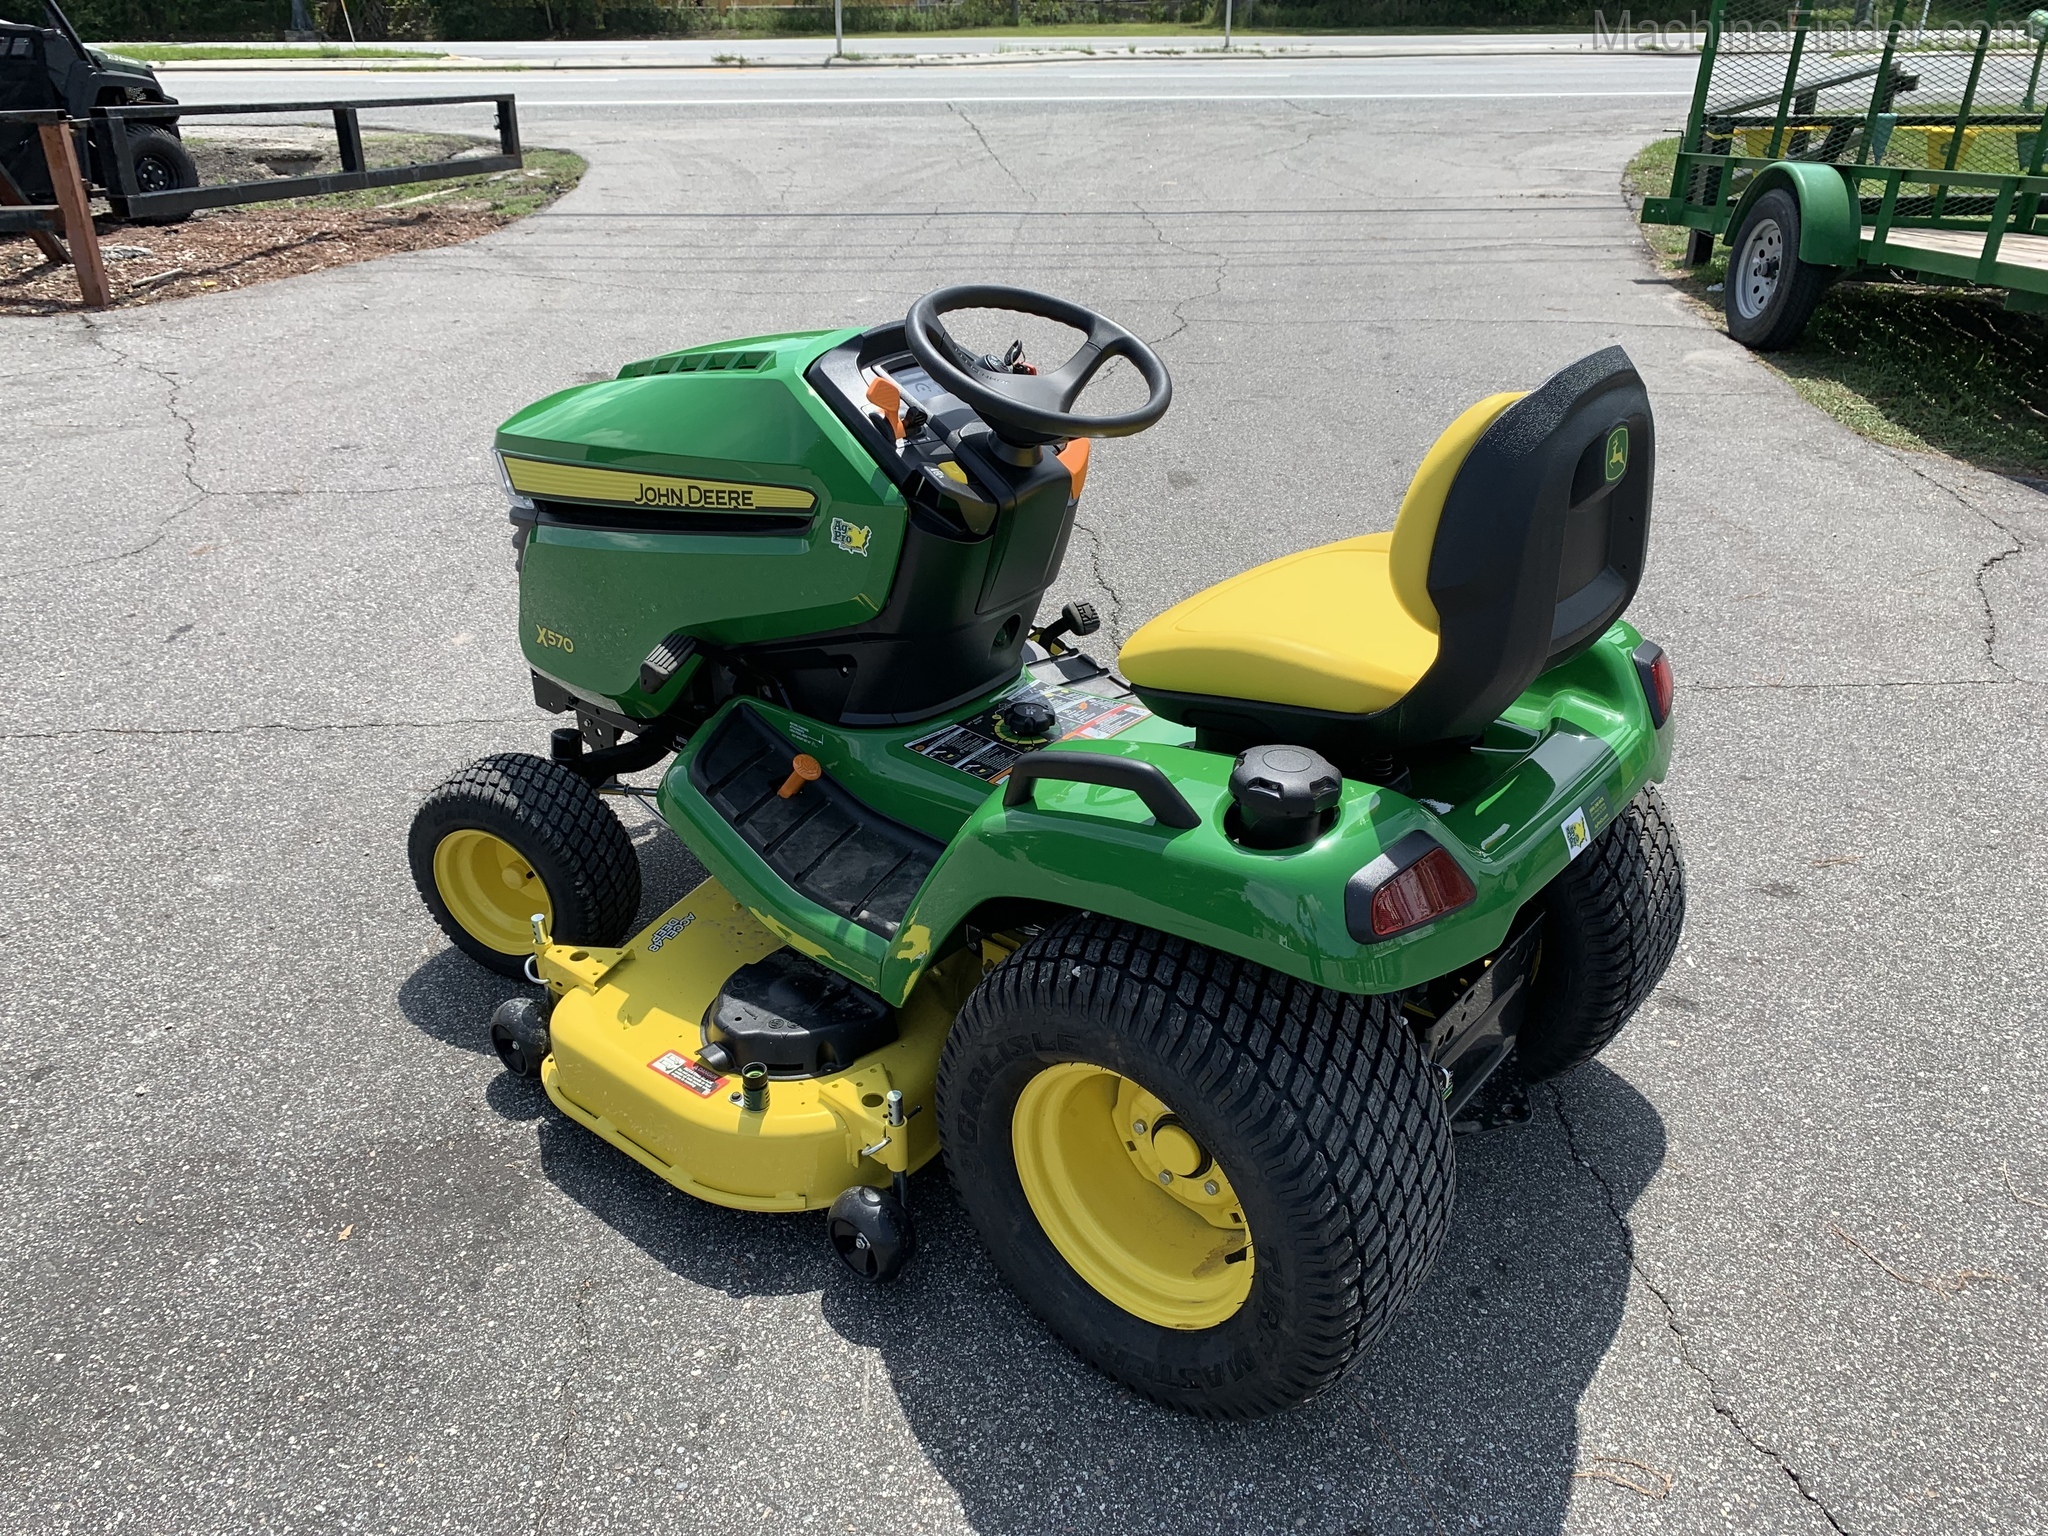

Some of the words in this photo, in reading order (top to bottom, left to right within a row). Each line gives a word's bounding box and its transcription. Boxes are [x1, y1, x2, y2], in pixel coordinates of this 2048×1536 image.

[634, 483, 684, 506] JOHN
[688, 486, 755, 508] DEERE
[834, 530, 851, 543] Pro
[535, 623, 575, 654] X570
[653, 917, 678, 942] DEEP
[660, 912, 695, 940] ACCEL
[956, 1032, 1081, 1145] CARLISLE
